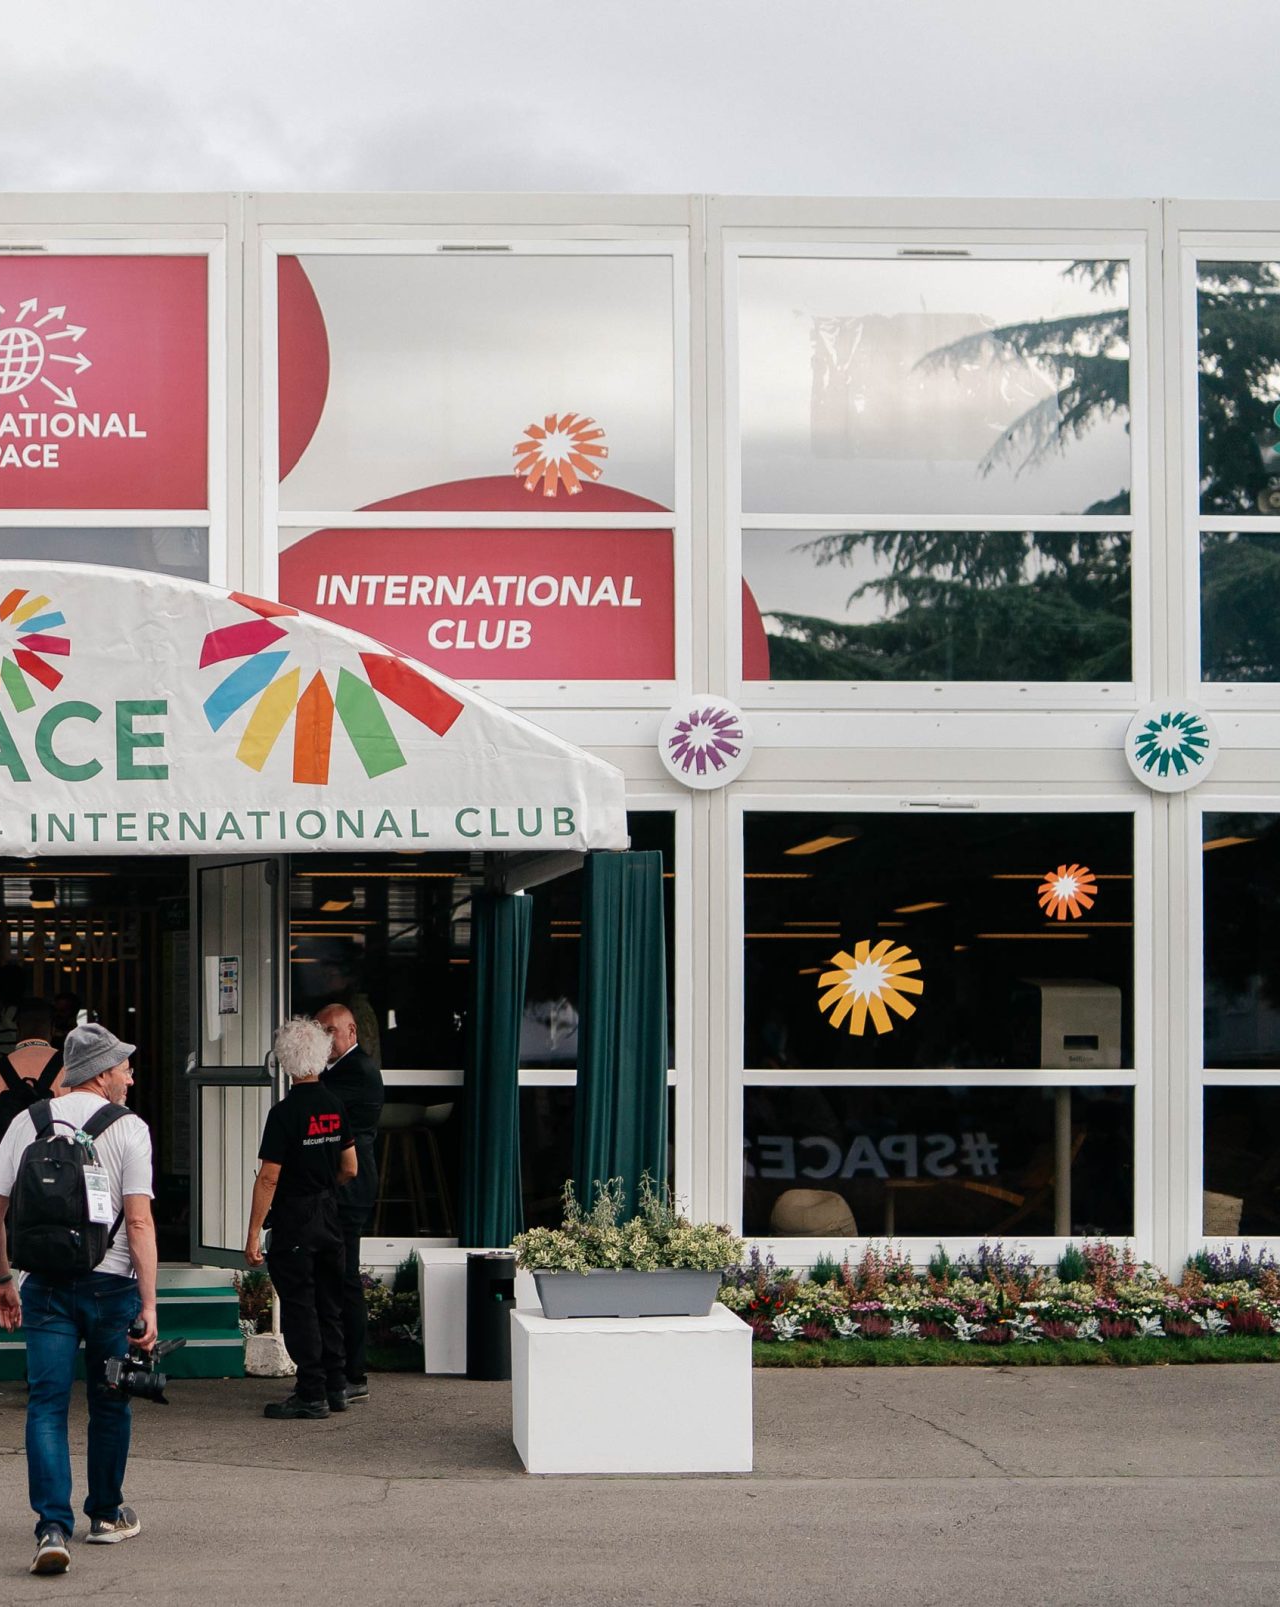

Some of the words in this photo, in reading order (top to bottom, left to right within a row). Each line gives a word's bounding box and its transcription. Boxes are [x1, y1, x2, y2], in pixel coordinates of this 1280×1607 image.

[315, 575, 642, 607] INTERNATIONAL
[427, 619, 532, 650] CLUB
[30, 808, 430, 843] INTERNATIONAL
[455, 805, 577, 837] CLUB
